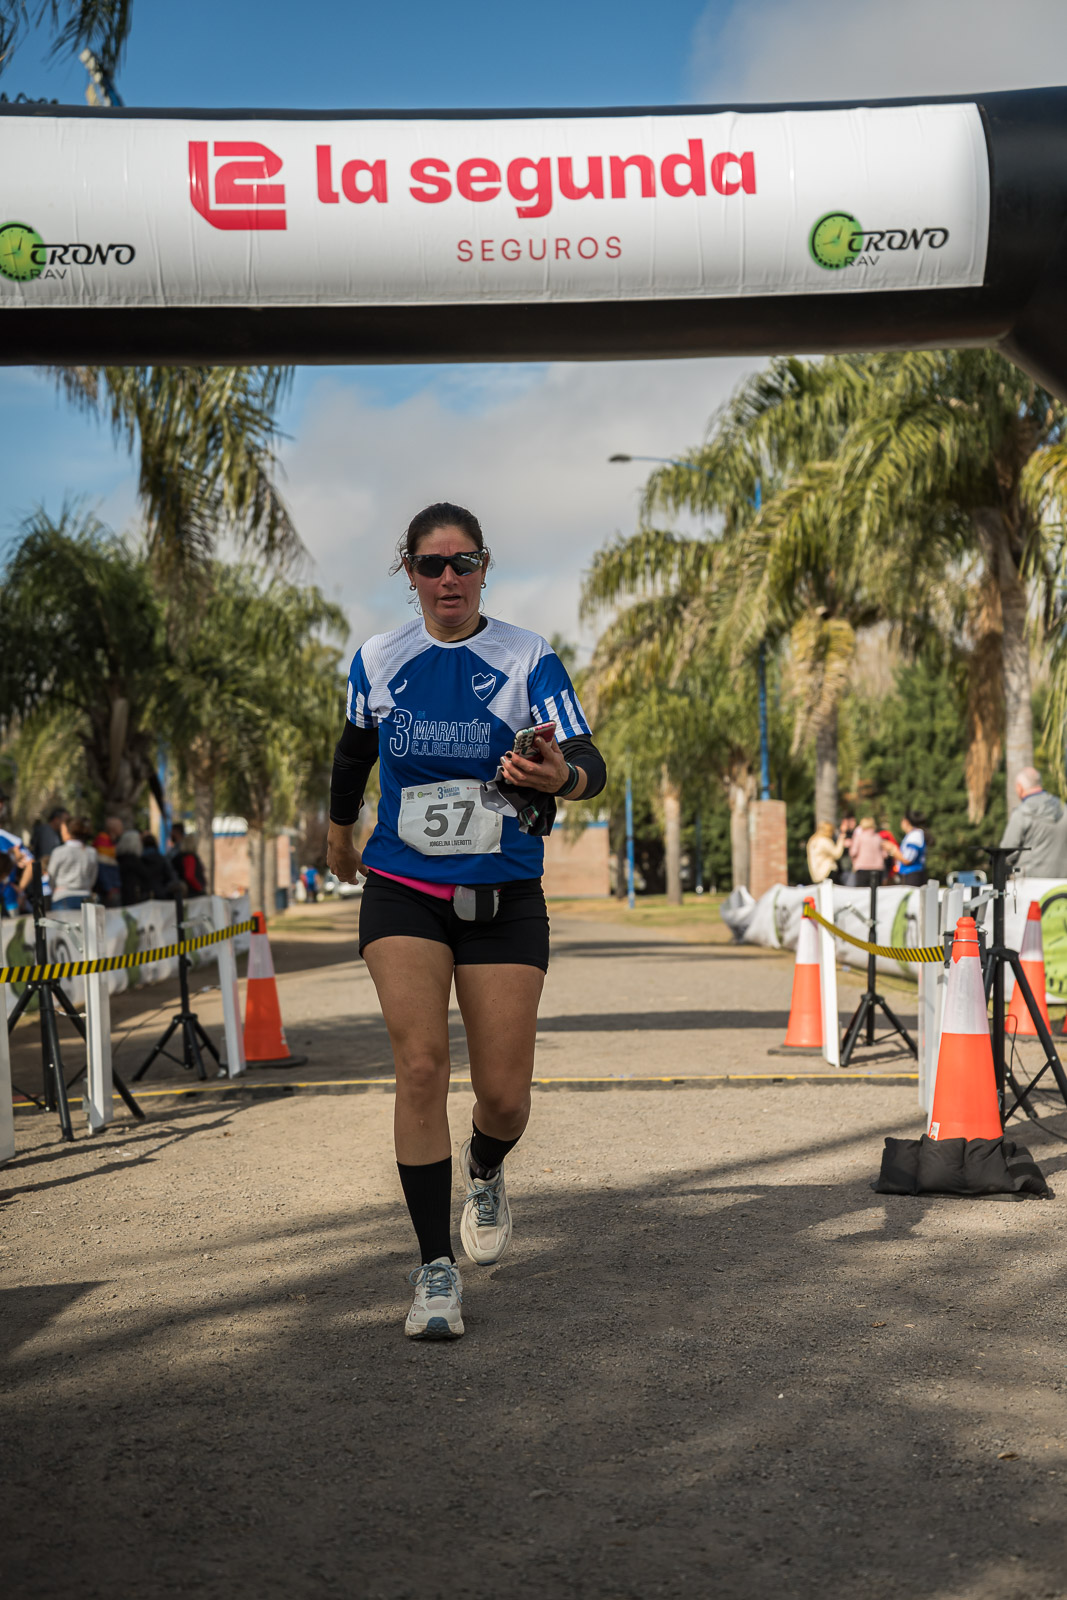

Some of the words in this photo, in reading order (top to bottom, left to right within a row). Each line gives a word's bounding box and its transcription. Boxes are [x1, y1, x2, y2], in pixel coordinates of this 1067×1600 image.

[315, 145, 389, 204] la
[409, 138, 758, 219] segunda
[456, 236, 623, 262] SEGUROS
[847, 226, 950, 253] CRONO
[30, 243, 136, 266] CRONO
[843, 255, 880, 267] RAV
[30, 268, 68, 280] RAV
[389, 708, 413, 758] 3
[412, 718, 491, 744] MARATÓN
[423, 800, 476, 838] 57
